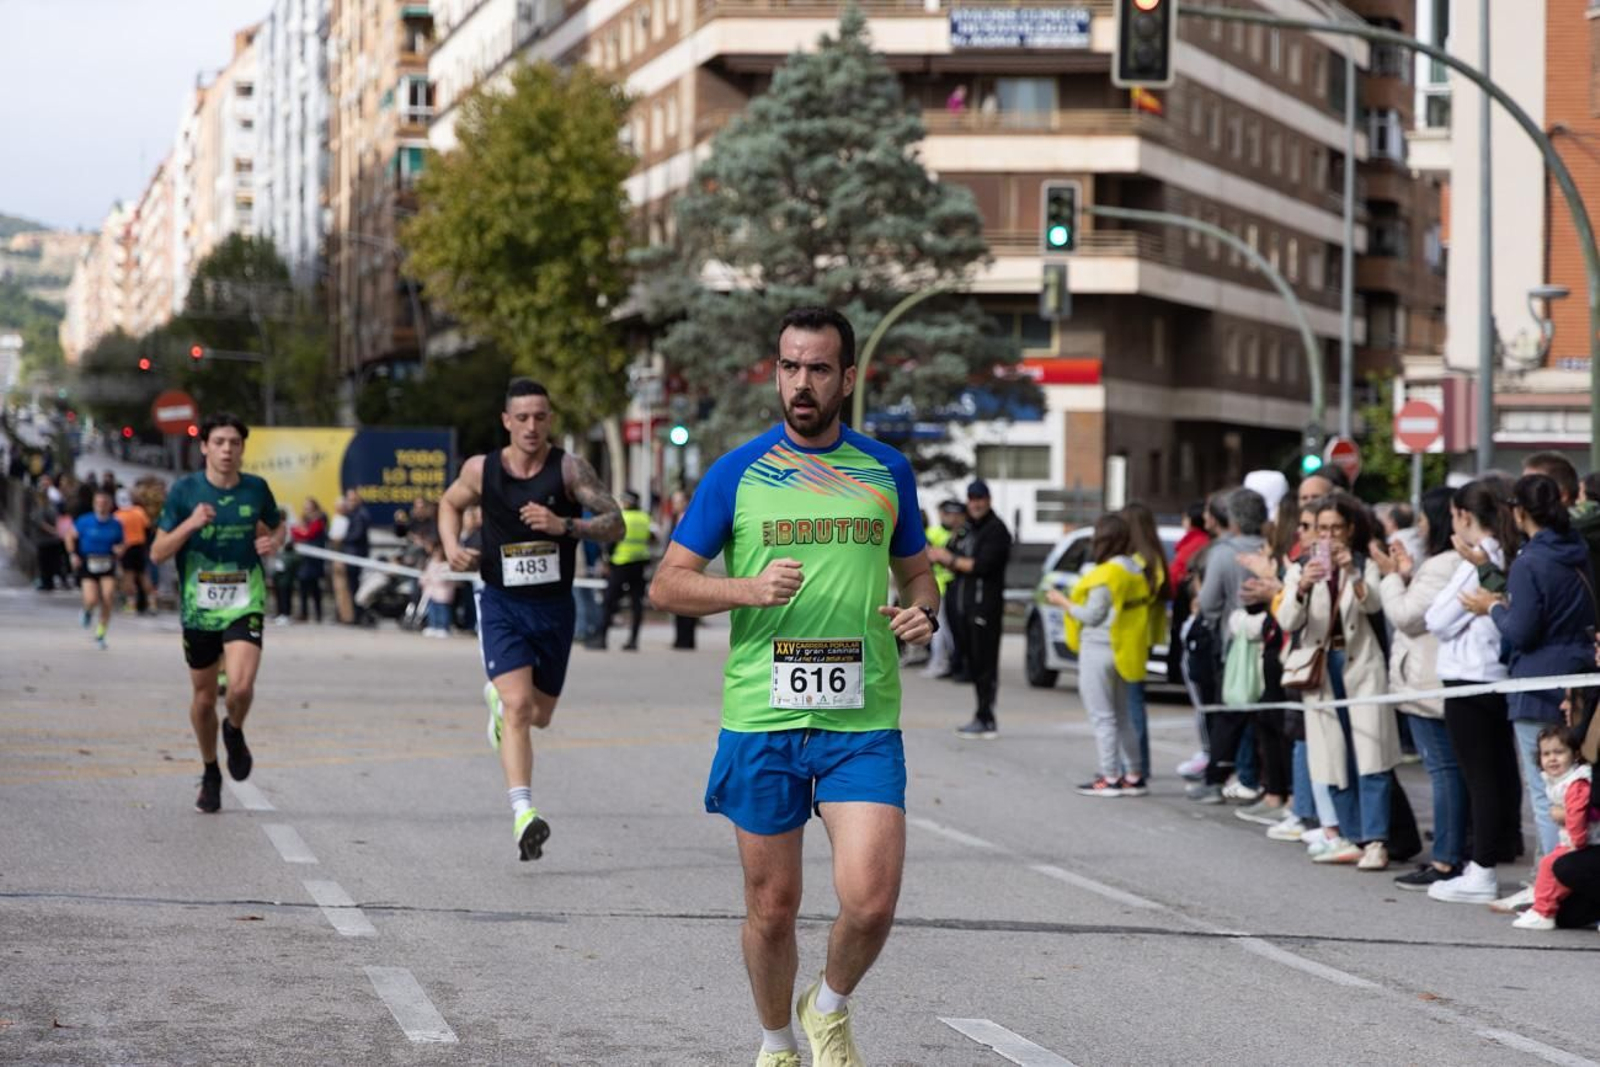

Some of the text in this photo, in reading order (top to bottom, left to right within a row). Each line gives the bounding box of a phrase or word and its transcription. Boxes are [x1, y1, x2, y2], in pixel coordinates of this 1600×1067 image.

[395, 449, 447, 468] TODO
[383, 467, 445, 486] LO QUE
[776, 517, 885, 546] BRUTUS
[515, 558, 548, 575] 483
[207, 585, 238, 600] 677
[776, 642, 796, 655] XXV
[790, 667, 846, 693] 616
